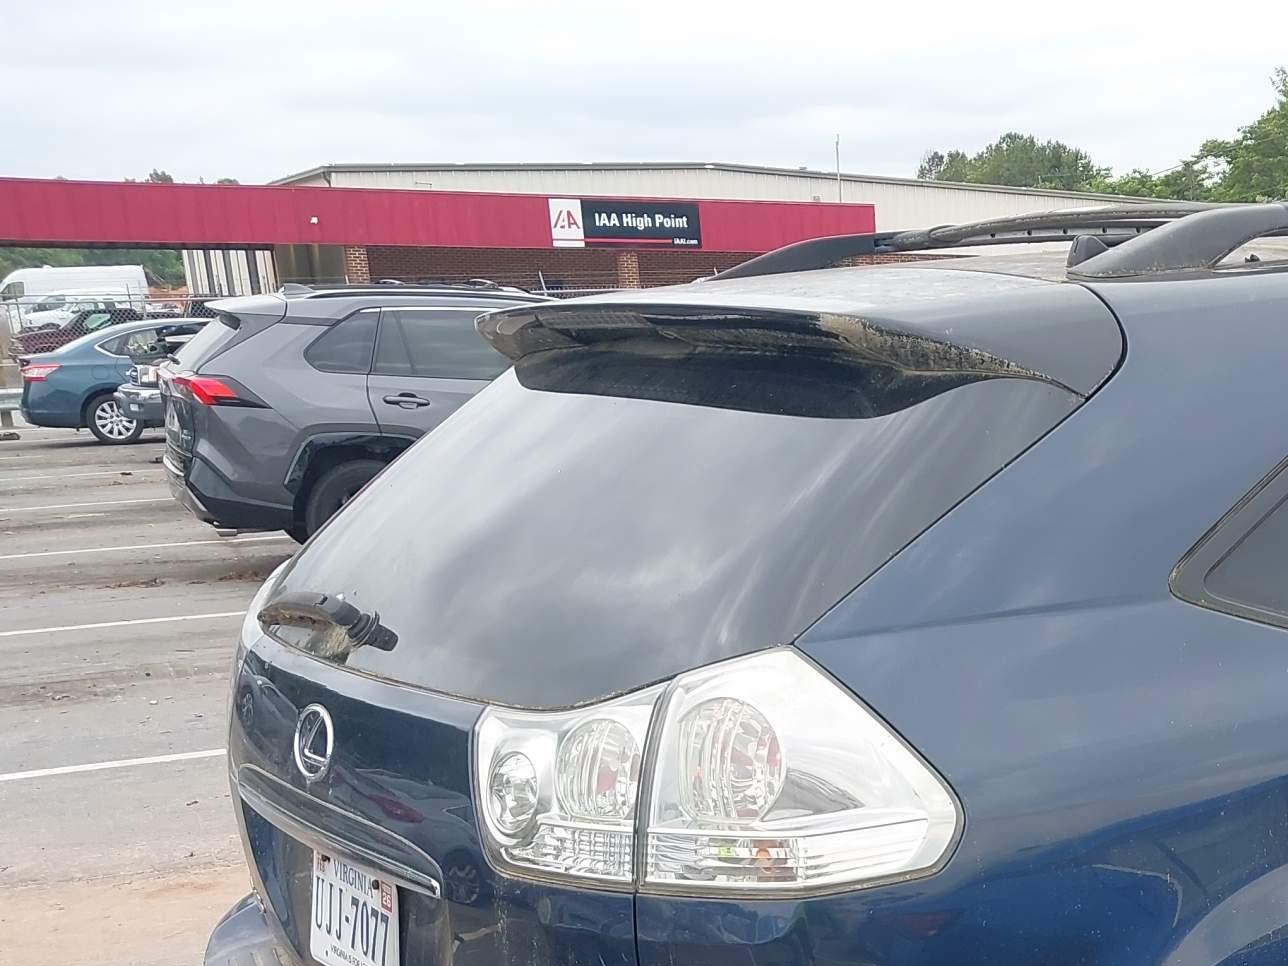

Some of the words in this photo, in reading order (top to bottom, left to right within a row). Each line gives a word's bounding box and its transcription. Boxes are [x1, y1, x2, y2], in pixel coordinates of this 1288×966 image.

[594, 213, 620, 227] IAA
[622, 213, 652, 230] High
[655, 213, 688, 228] Point
[333, 860, 373, 898] VIRGINIA
